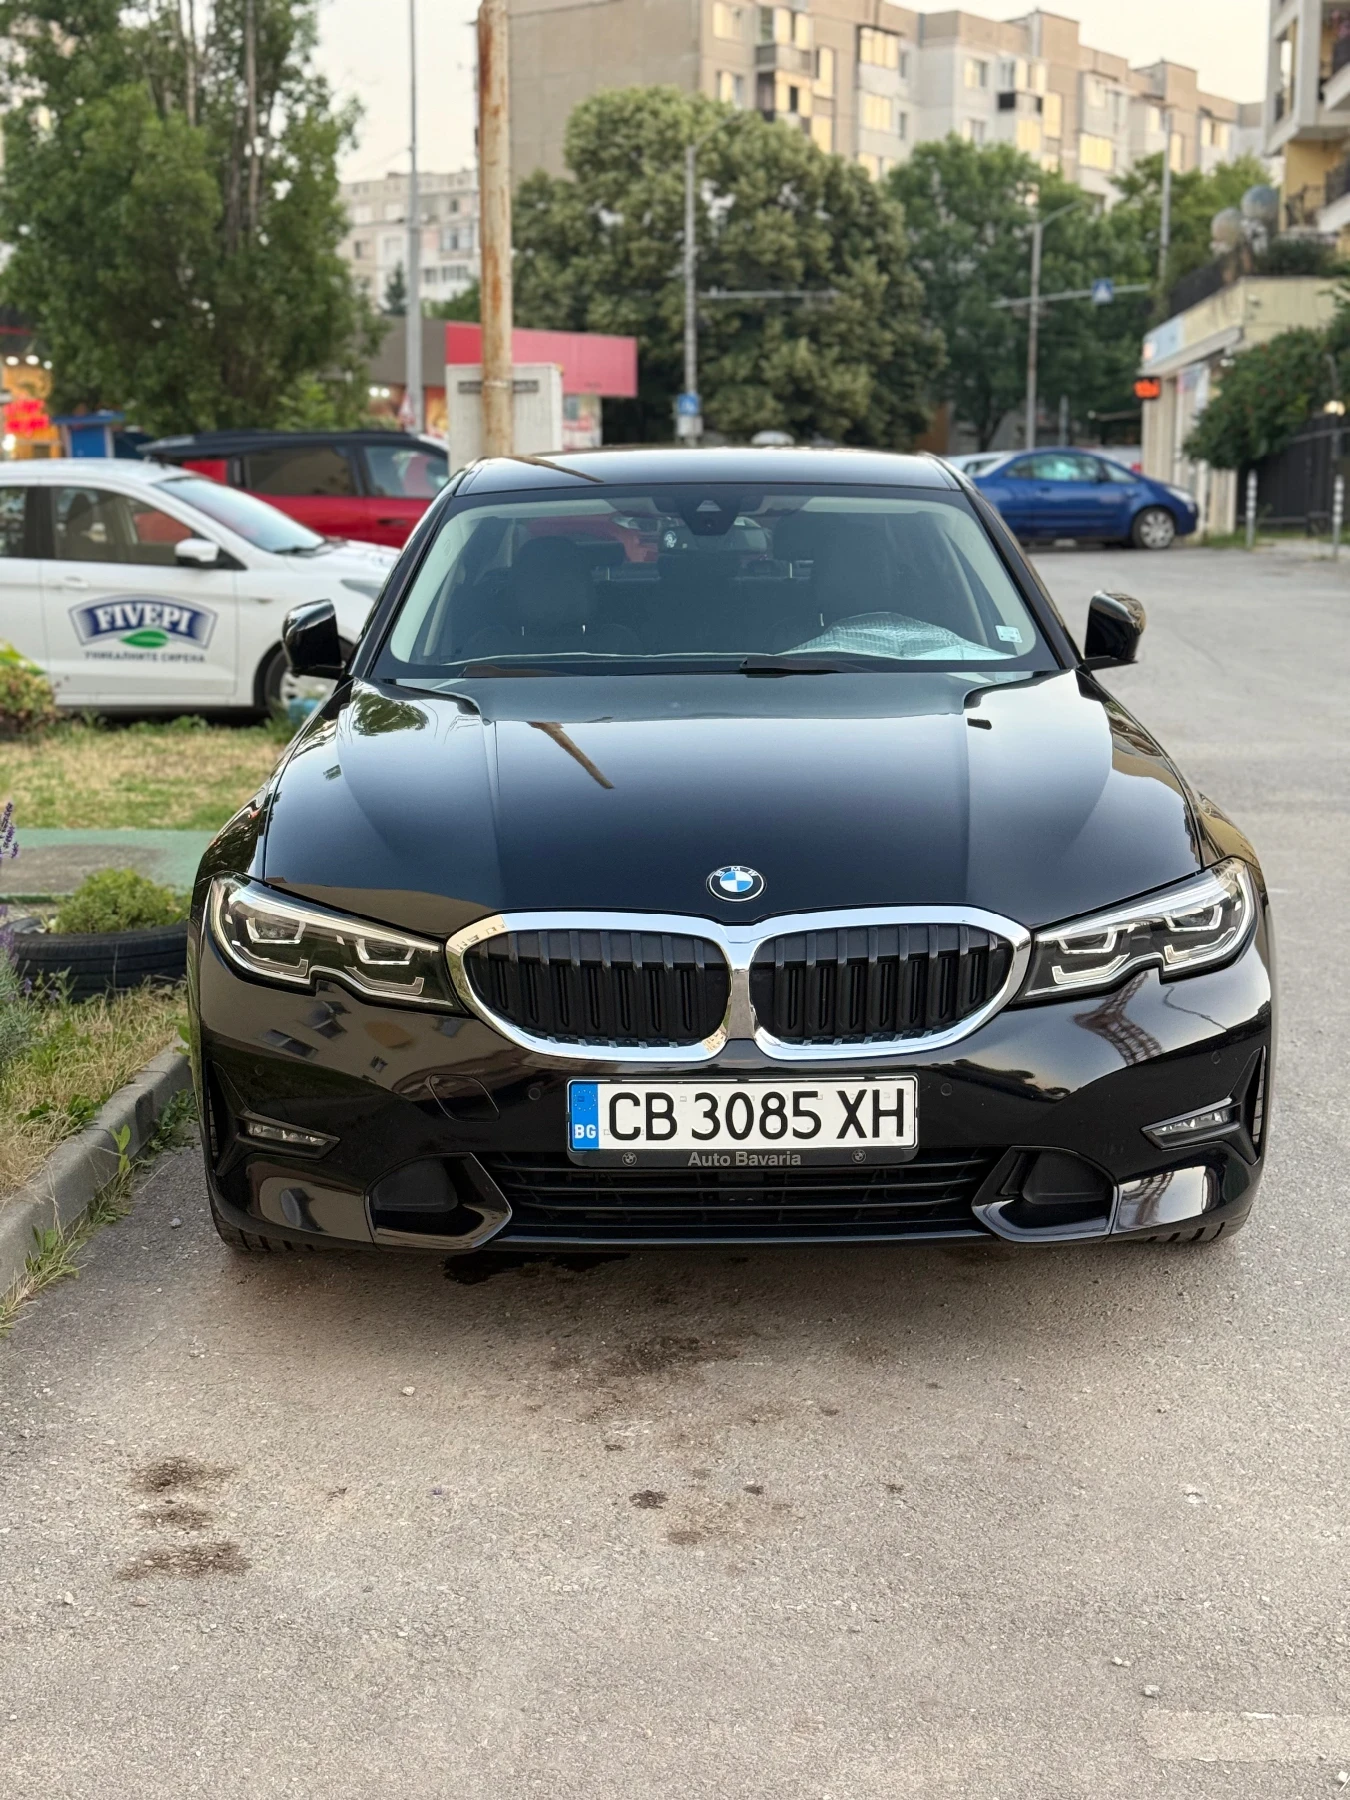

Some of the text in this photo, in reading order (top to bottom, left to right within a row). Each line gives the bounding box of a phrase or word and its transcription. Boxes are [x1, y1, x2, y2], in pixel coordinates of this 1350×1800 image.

[94, 603, 193, 633] FIVEPI
[608, 1088, 904, 1141] CB 3085 XH
[574, 1124, 597, 1139] BG
[687, 1151, 801, 1167] Auto Bavaria
